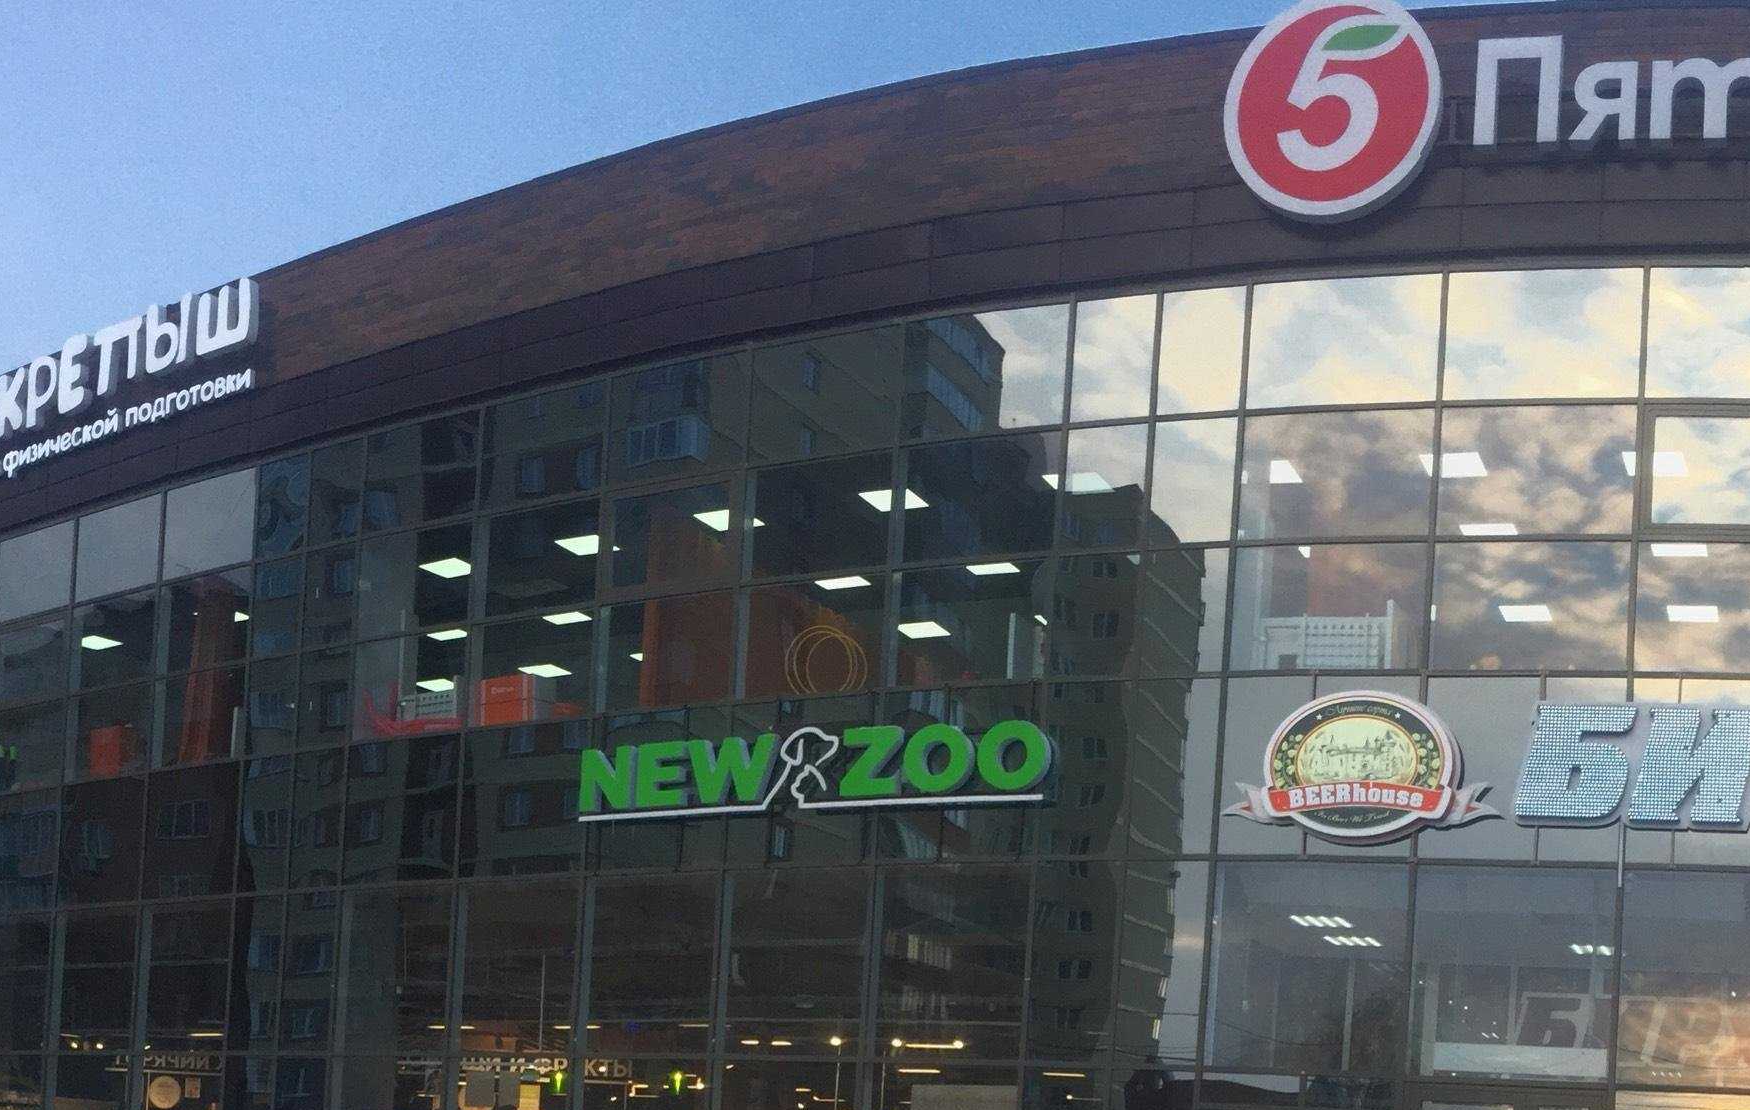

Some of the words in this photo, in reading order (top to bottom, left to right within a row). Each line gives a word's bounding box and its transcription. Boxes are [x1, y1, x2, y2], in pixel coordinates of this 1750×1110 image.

[3, 409, 120, 478] физической
[125, 368, 253, 428] подготовки
[580, 733, 778, 812] NEW
[840, 720, 1056, 797] ZOO
[1288, 783, 1425, 809] BEERhouse
[533, 1057, 632, 1078] ФРКТЫ
